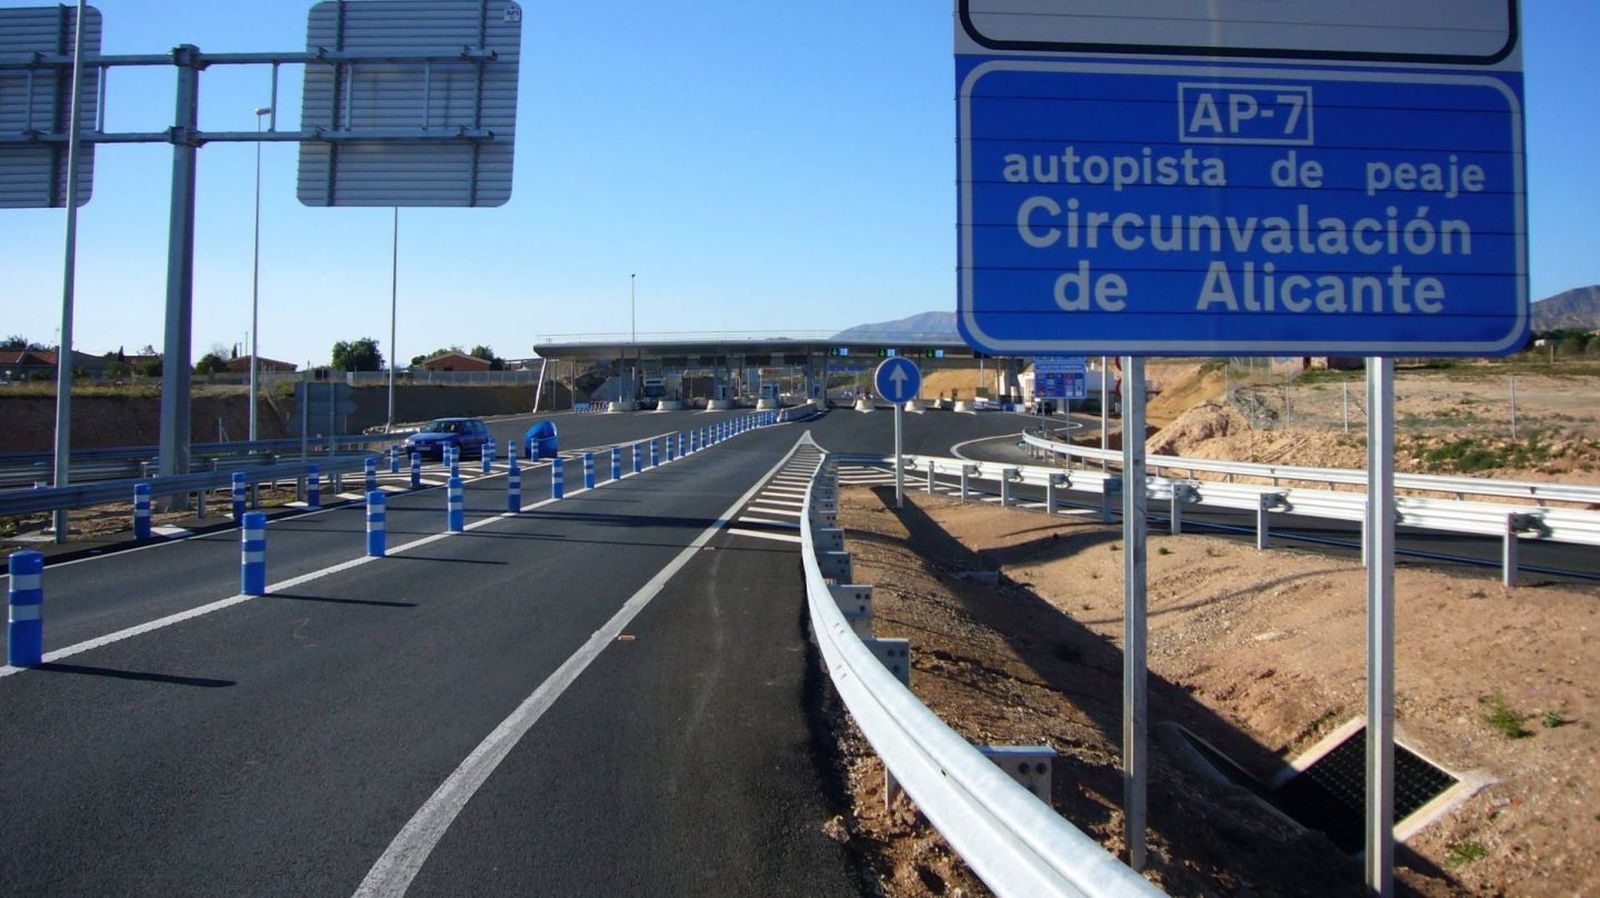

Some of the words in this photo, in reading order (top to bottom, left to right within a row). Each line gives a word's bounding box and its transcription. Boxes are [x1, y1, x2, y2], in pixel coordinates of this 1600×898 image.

[1190, 93, 1303, 133] AP-7
[1004, 146, 1226, 191] autopista
[1272, 151, 1323, 188] de
[1367, 156, 1485, 198] peaje
[1018, 196, 1470, 254] Circunvalación
[1055, 261, 1127, 311] de
[1197, 261, 1444, 312] Alicante
